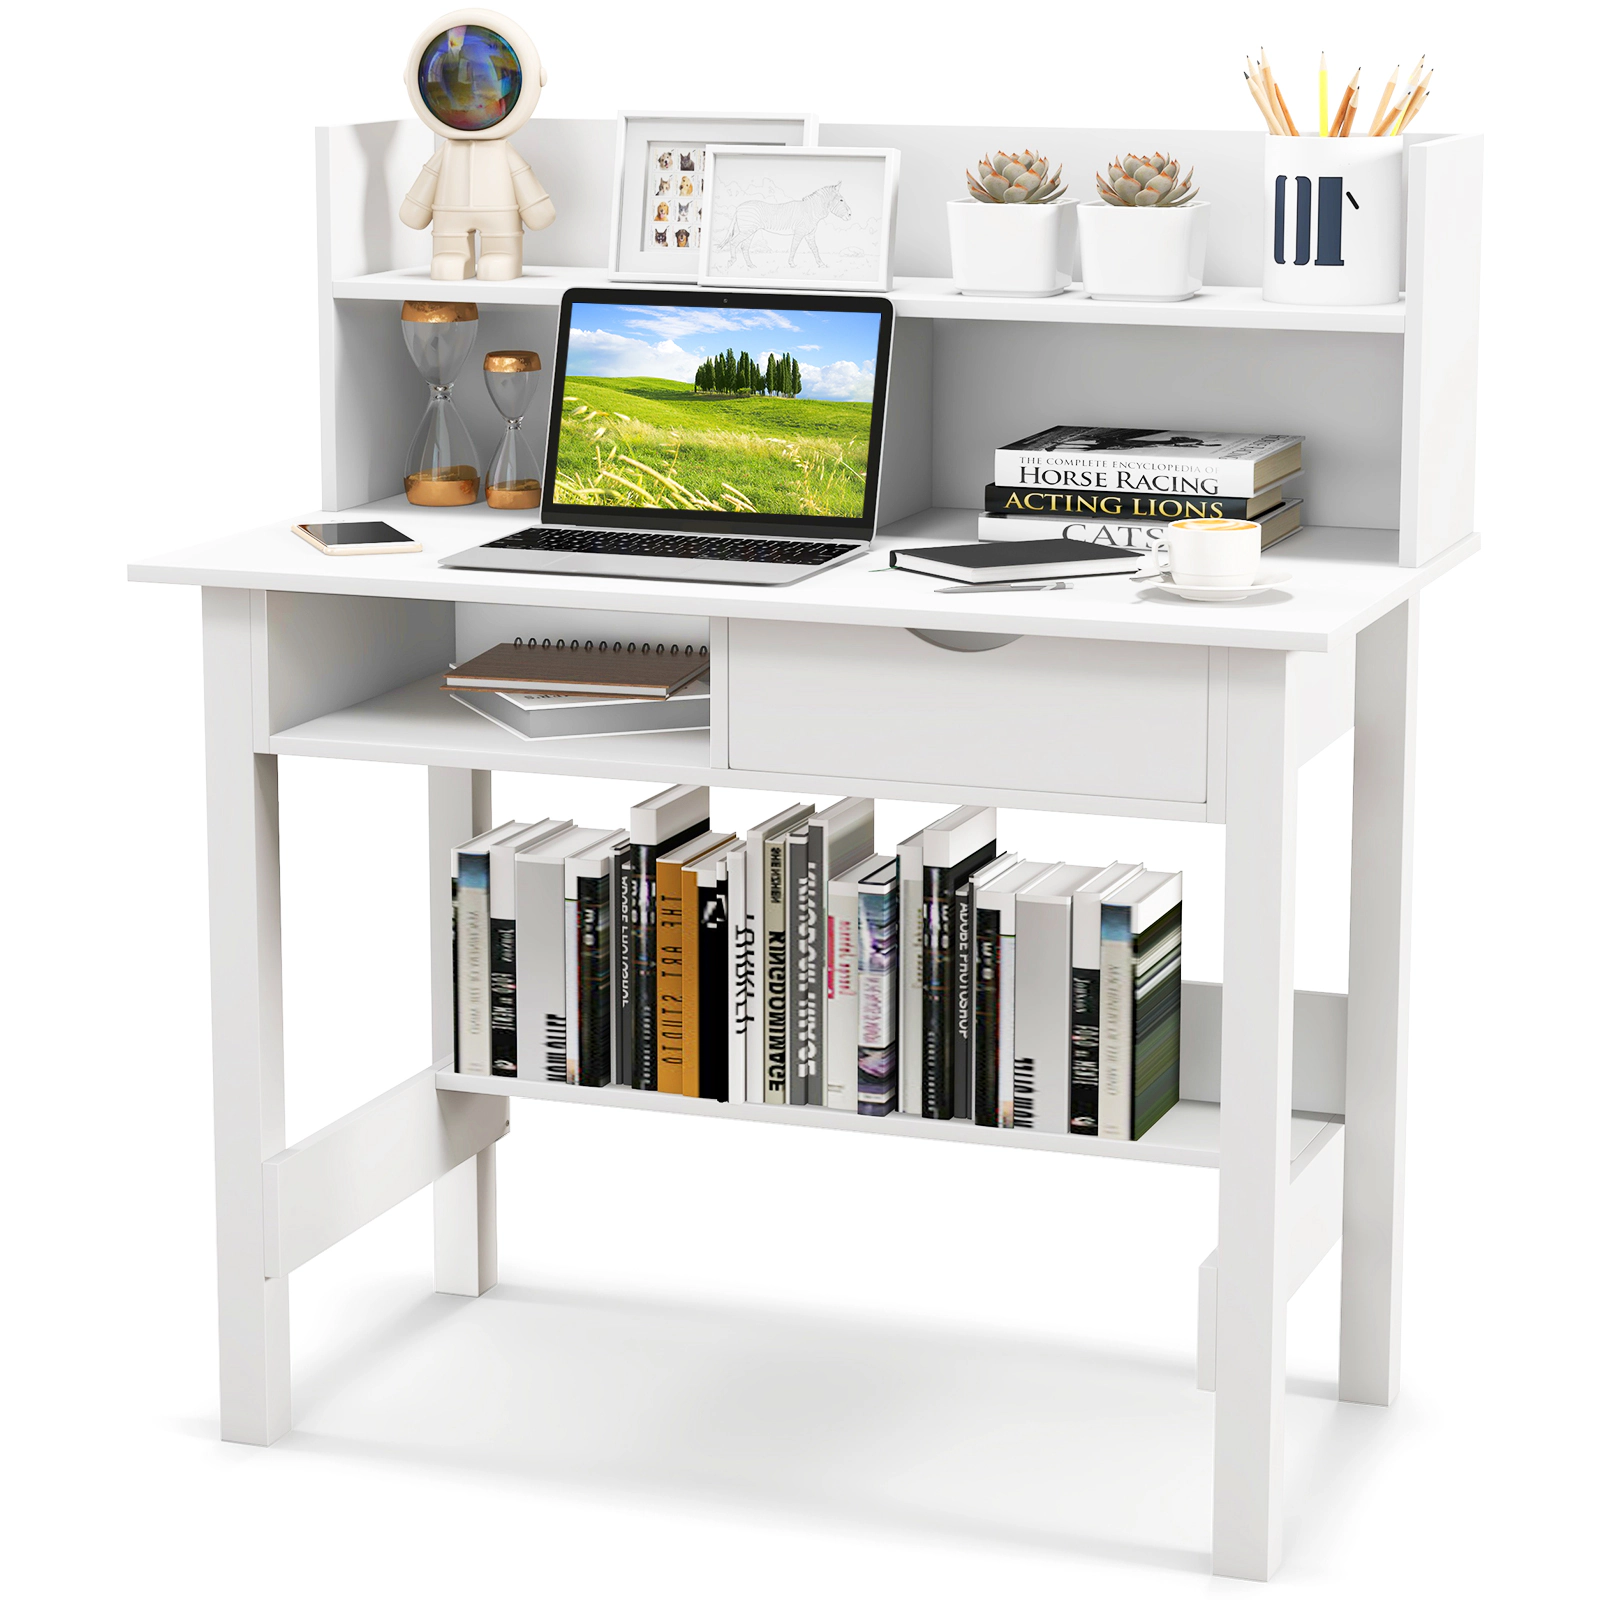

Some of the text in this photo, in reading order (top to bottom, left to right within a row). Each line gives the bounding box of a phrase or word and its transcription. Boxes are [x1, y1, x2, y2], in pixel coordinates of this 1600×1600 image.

[1019, 456, 1042, 465] THE
[1046, 457, 1108, 468] COMPLETE
[1112, 460, 1201, 474] ENCYCLOPEDIA
[1019, 466, 1219, 496] HORSE RACING
[1003, 491, 1225, 519] ACTING LIONS
[1062, 523, 1166, 549] CATS
